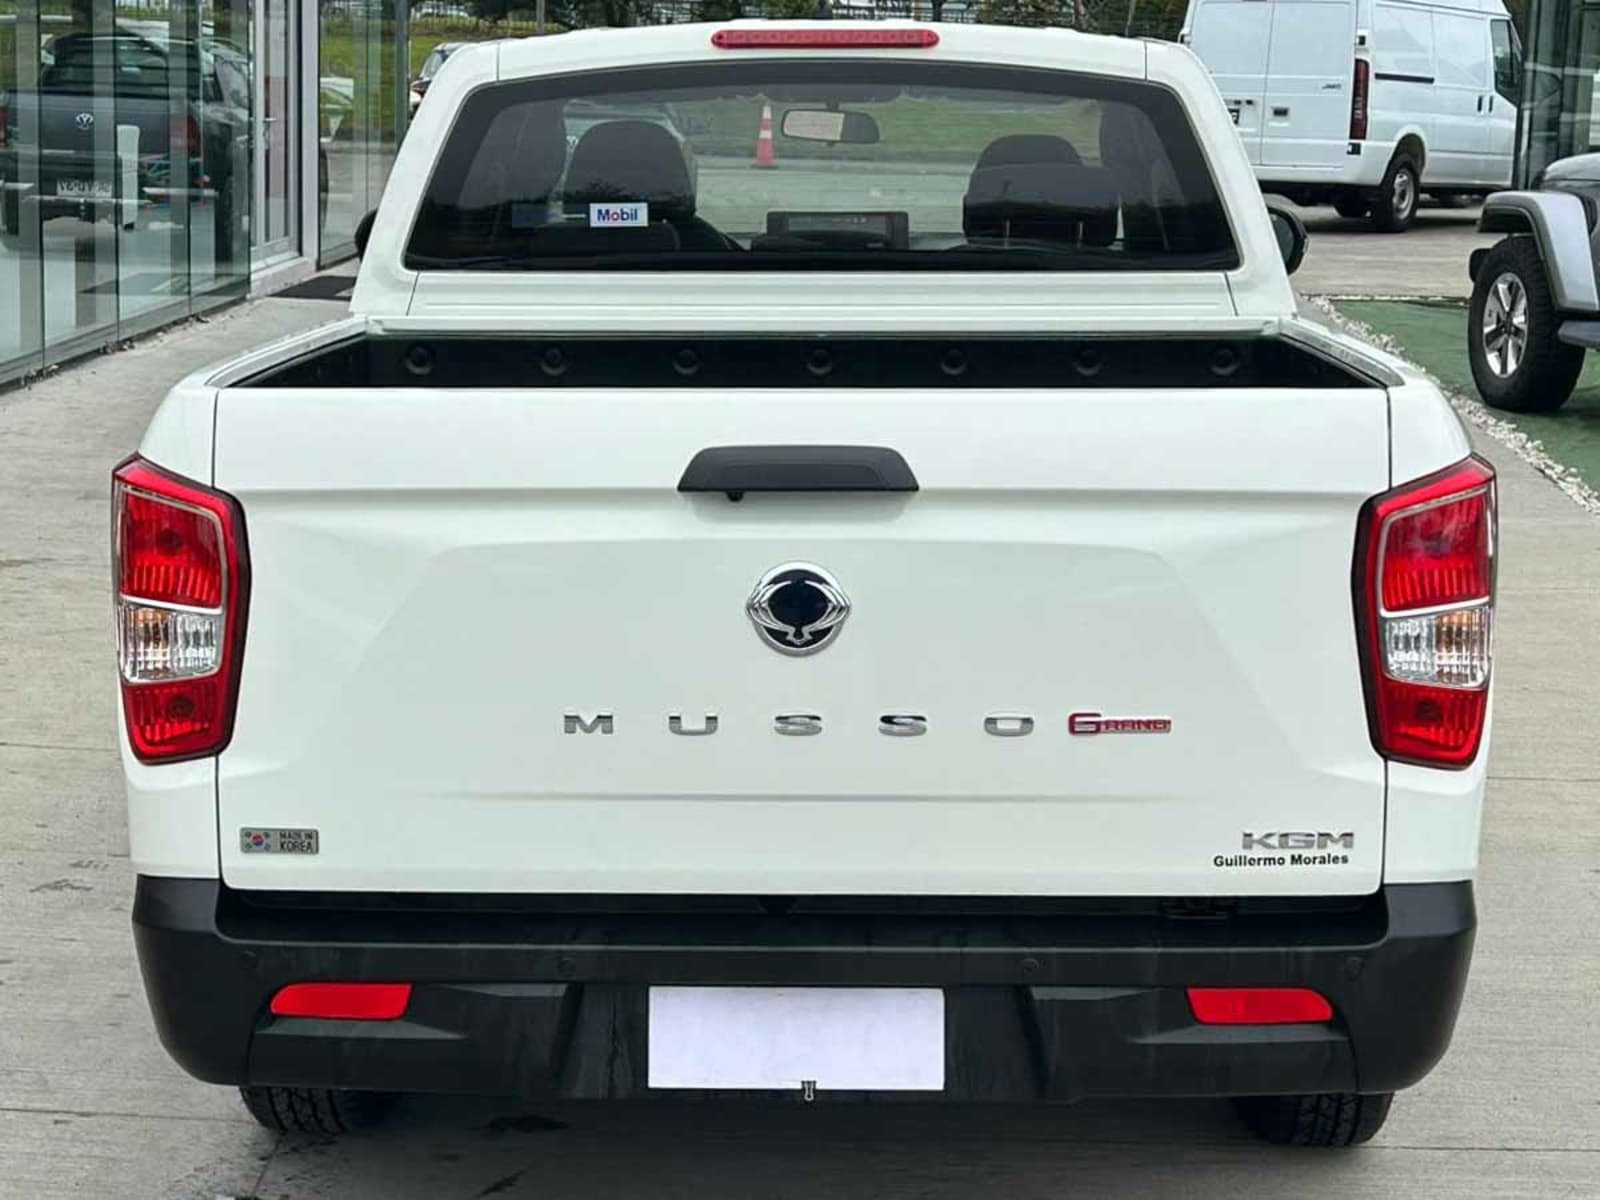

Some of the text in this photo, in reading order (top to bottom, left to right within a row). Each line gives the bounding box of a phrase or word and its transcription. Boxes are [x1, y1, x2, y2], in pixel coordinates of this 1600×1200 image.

[597, 208, 638, 221] Mobil
[564, 714, 1035, 736] MUSSO
[280, 840, 313, 850] KOREA
[1242, 832, 1354, 850] KGM
[1213, 853, 1349, 867] Guillermo Morales
